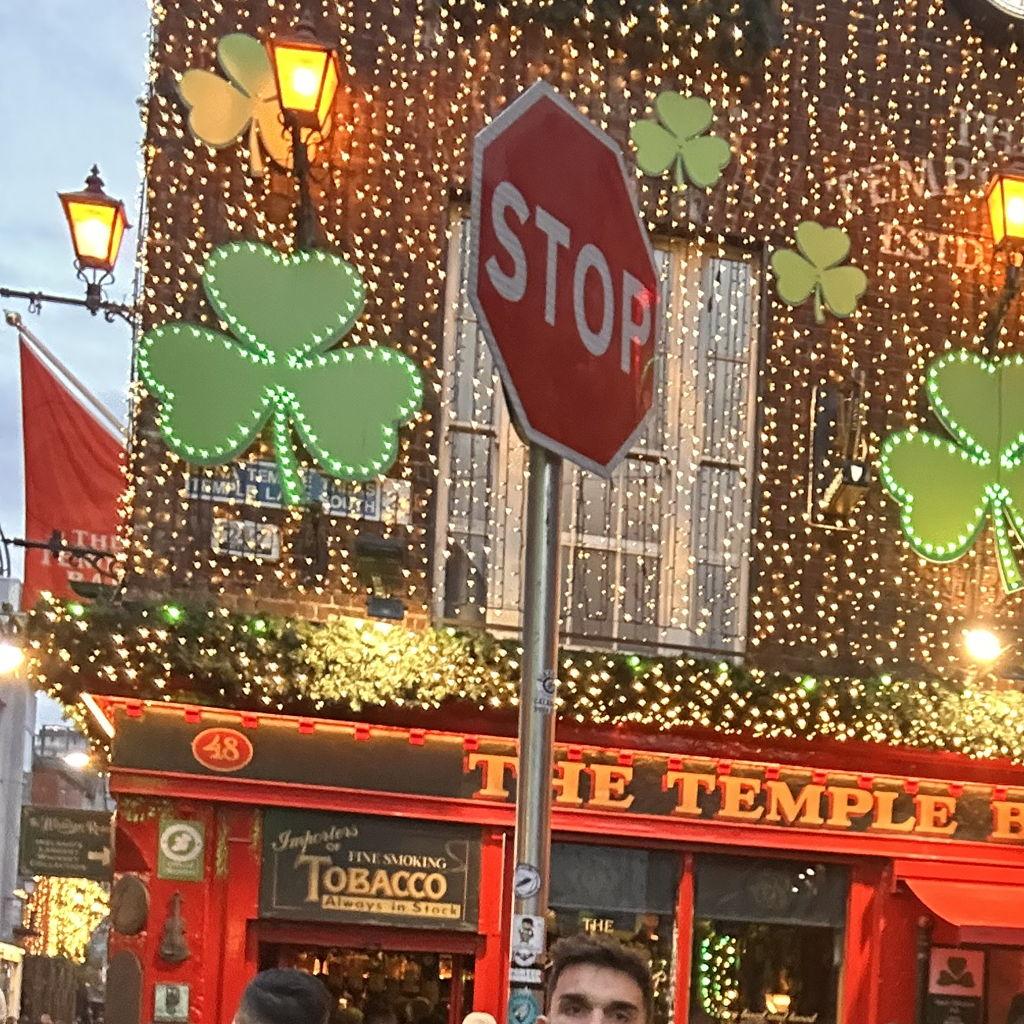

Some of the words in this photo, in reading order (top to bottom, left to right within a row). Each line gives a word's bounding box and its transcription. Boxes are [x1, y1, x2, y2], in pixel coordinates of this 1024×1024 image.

[826, 157, 990, 213] TEMP
[485, 180, 651, 374] STOP
[203, 734, 240, 761] 48
[464, 752, 636, 809] THE
[665, 770, 957, 836] TEMPLE
[294, 853, 447, 902] TOBACCO
[348, 850, 380, 864] FINE
[382, 853, 447, 869] SMOKING
[324, 894, 384, 911] Always
[391, 902, 406, 912] in
[412, 904, 458, 916] Stock
[583, 918, 615, 933] THE
